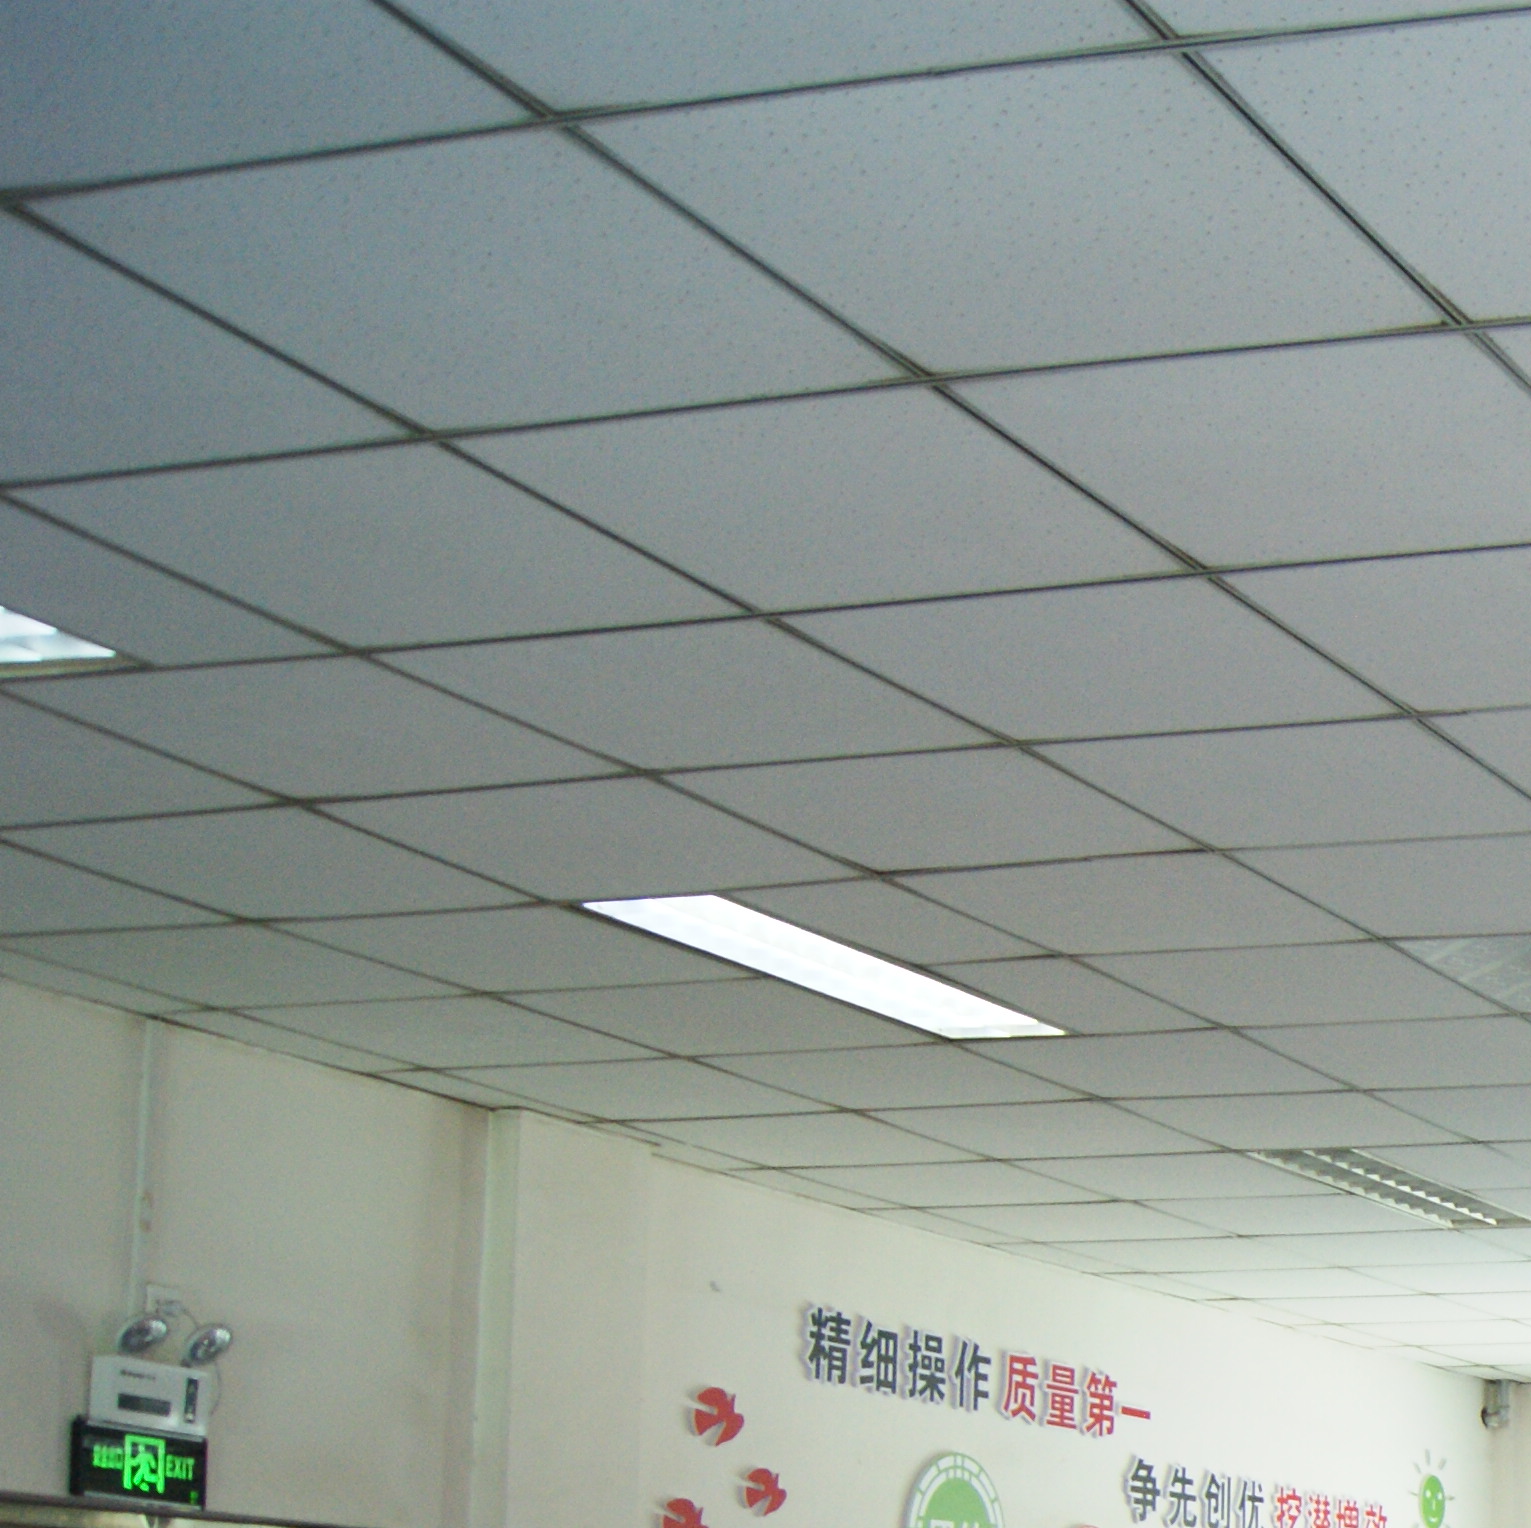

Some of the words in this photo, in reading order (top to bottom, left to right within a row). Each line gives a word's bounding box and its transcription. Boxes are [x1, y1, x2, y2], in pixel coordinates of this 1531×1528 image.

[806, 1306, 1152, 1437] 精细操作质量第一
[165, 1454, 195, 1480] EXIT
